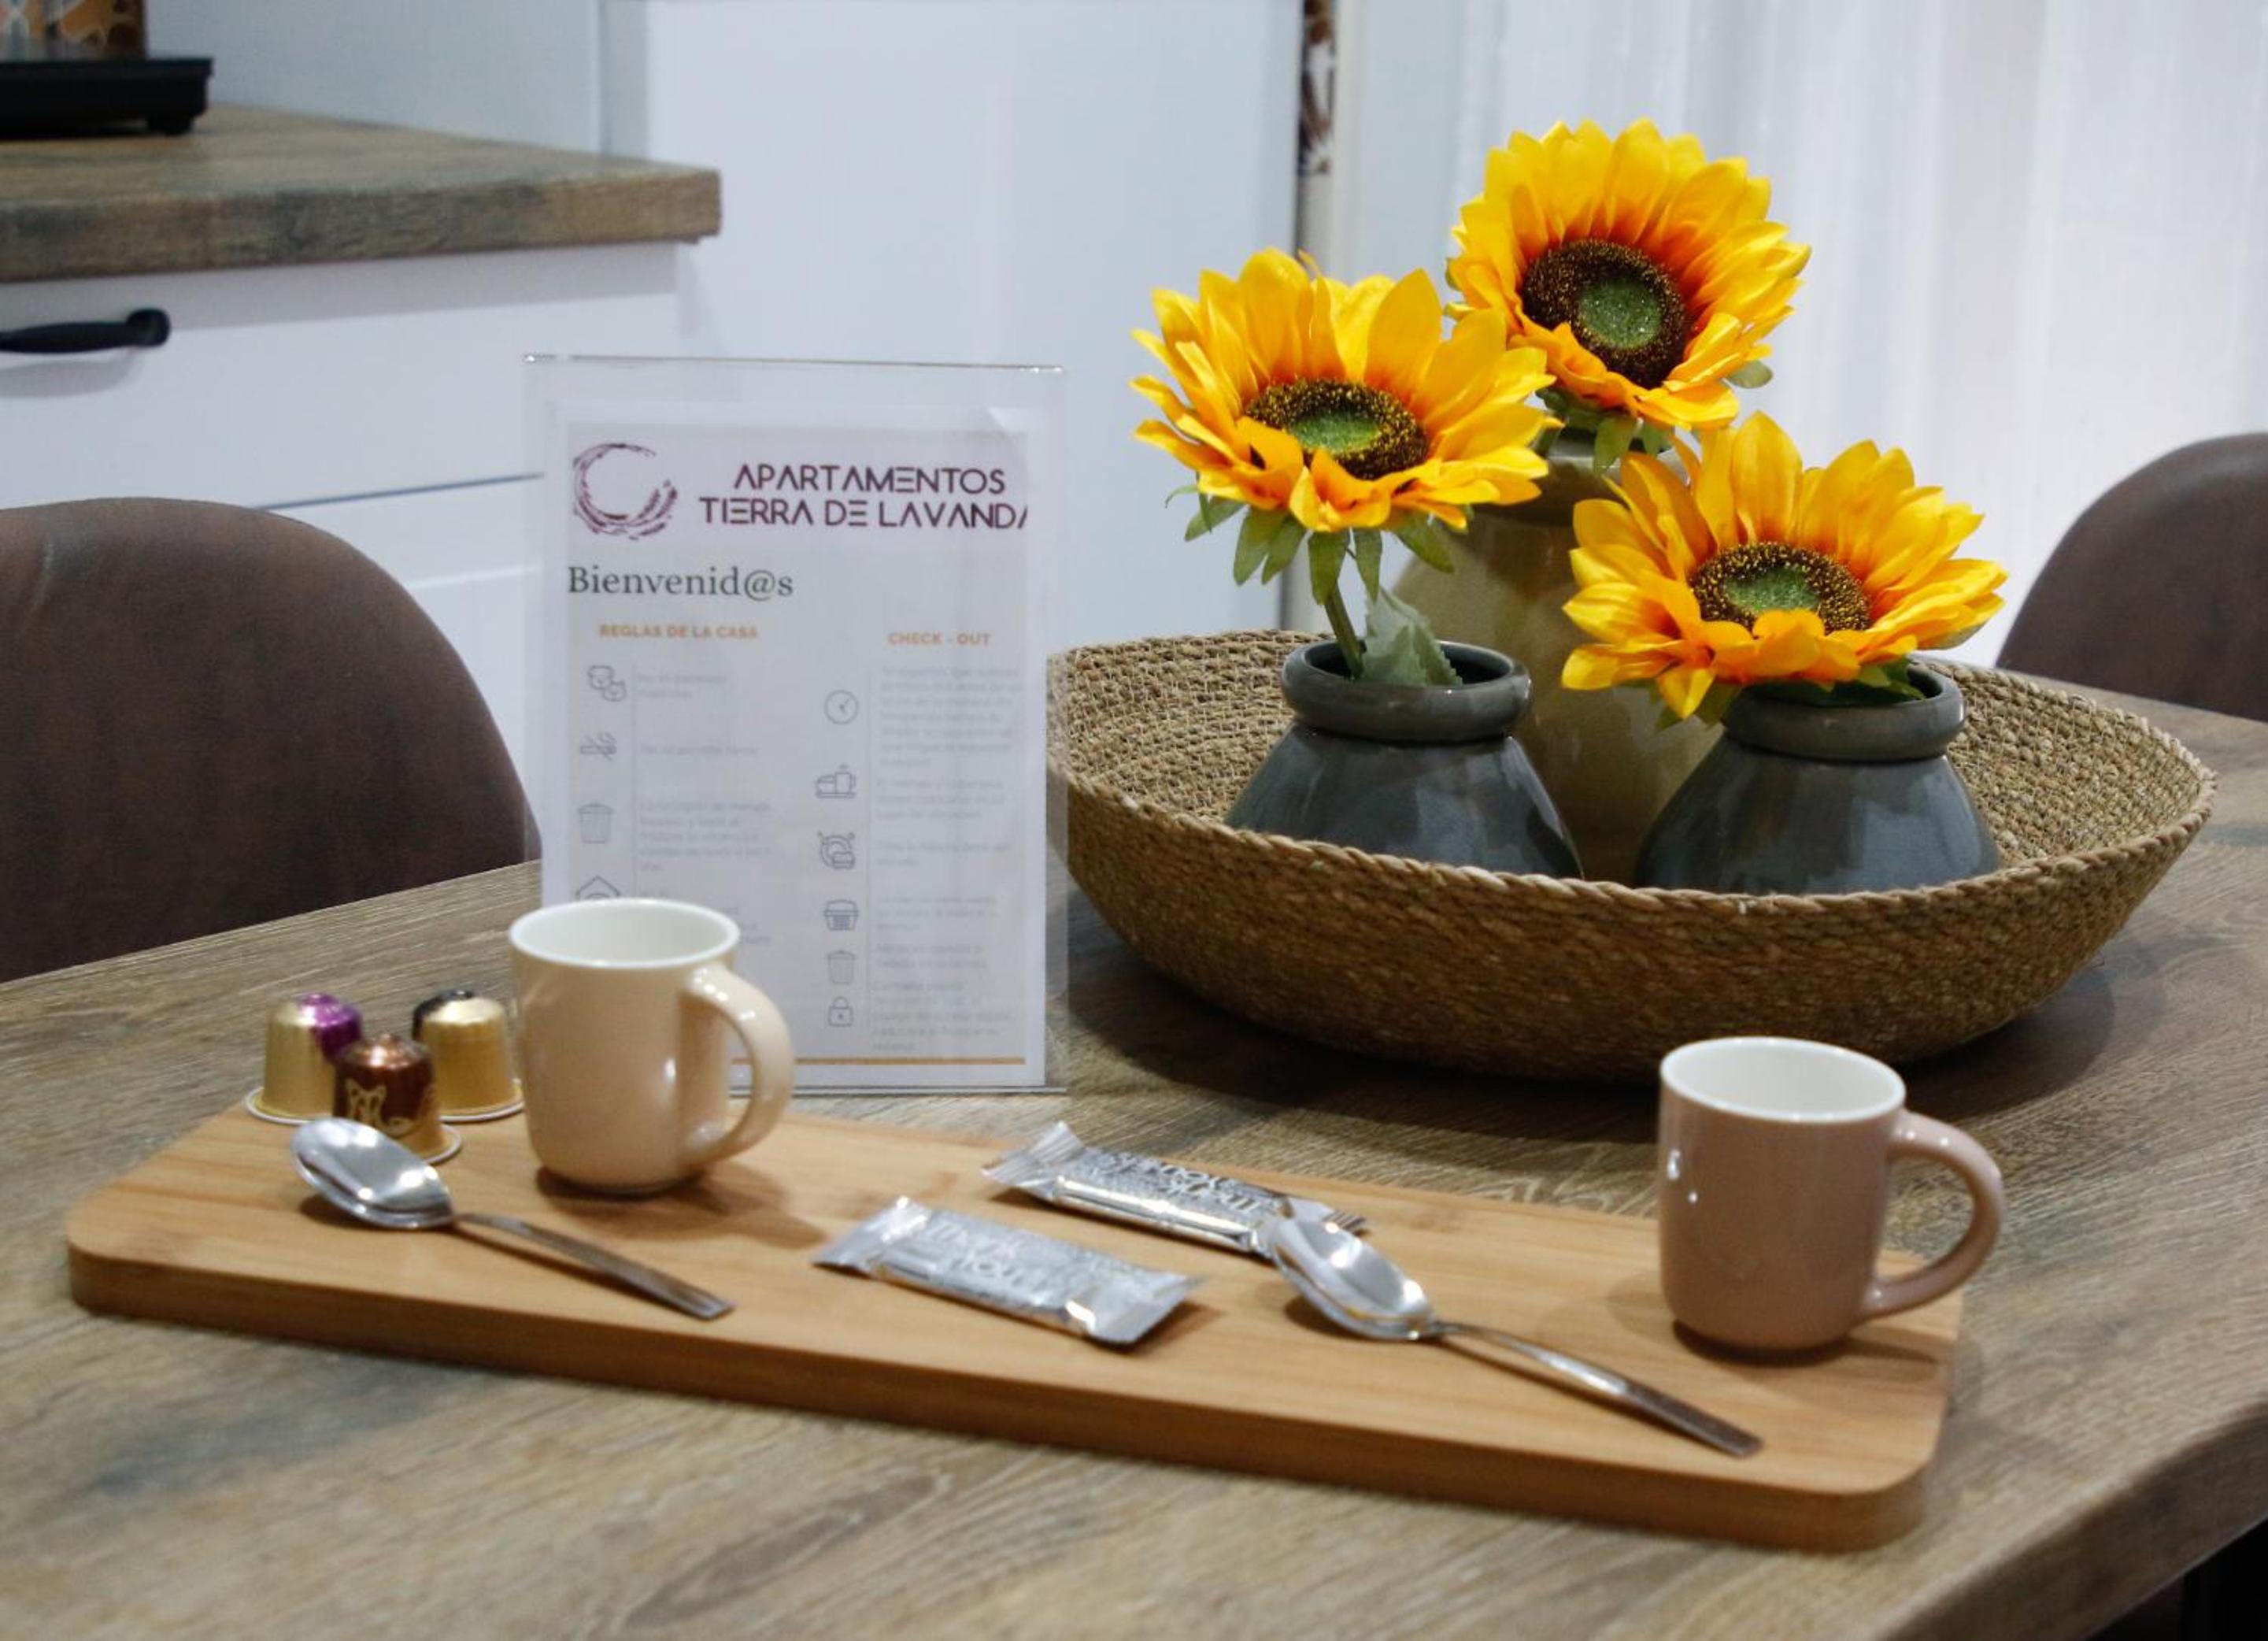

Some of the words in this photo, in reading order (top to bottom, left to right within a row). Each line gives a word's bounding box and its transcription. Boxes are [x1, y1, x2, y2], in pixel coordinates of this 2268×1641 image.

[734, 463, 1006, 495] APARTAMENTOS
[699, 496, 814, 525] TIERRA
[824, 499, 868, 527] DE
[568, 565, 794, 601] Bienvenid@s
[598, 624, 662, 639] REGLAS
[666, 624, 687, 639] DE
[692, 625, 712, 639] LA
[716, 626, 758, 639] CASA
[887, 632, 942, 646] CHECK
[956, 632, 992, 646] OUT
